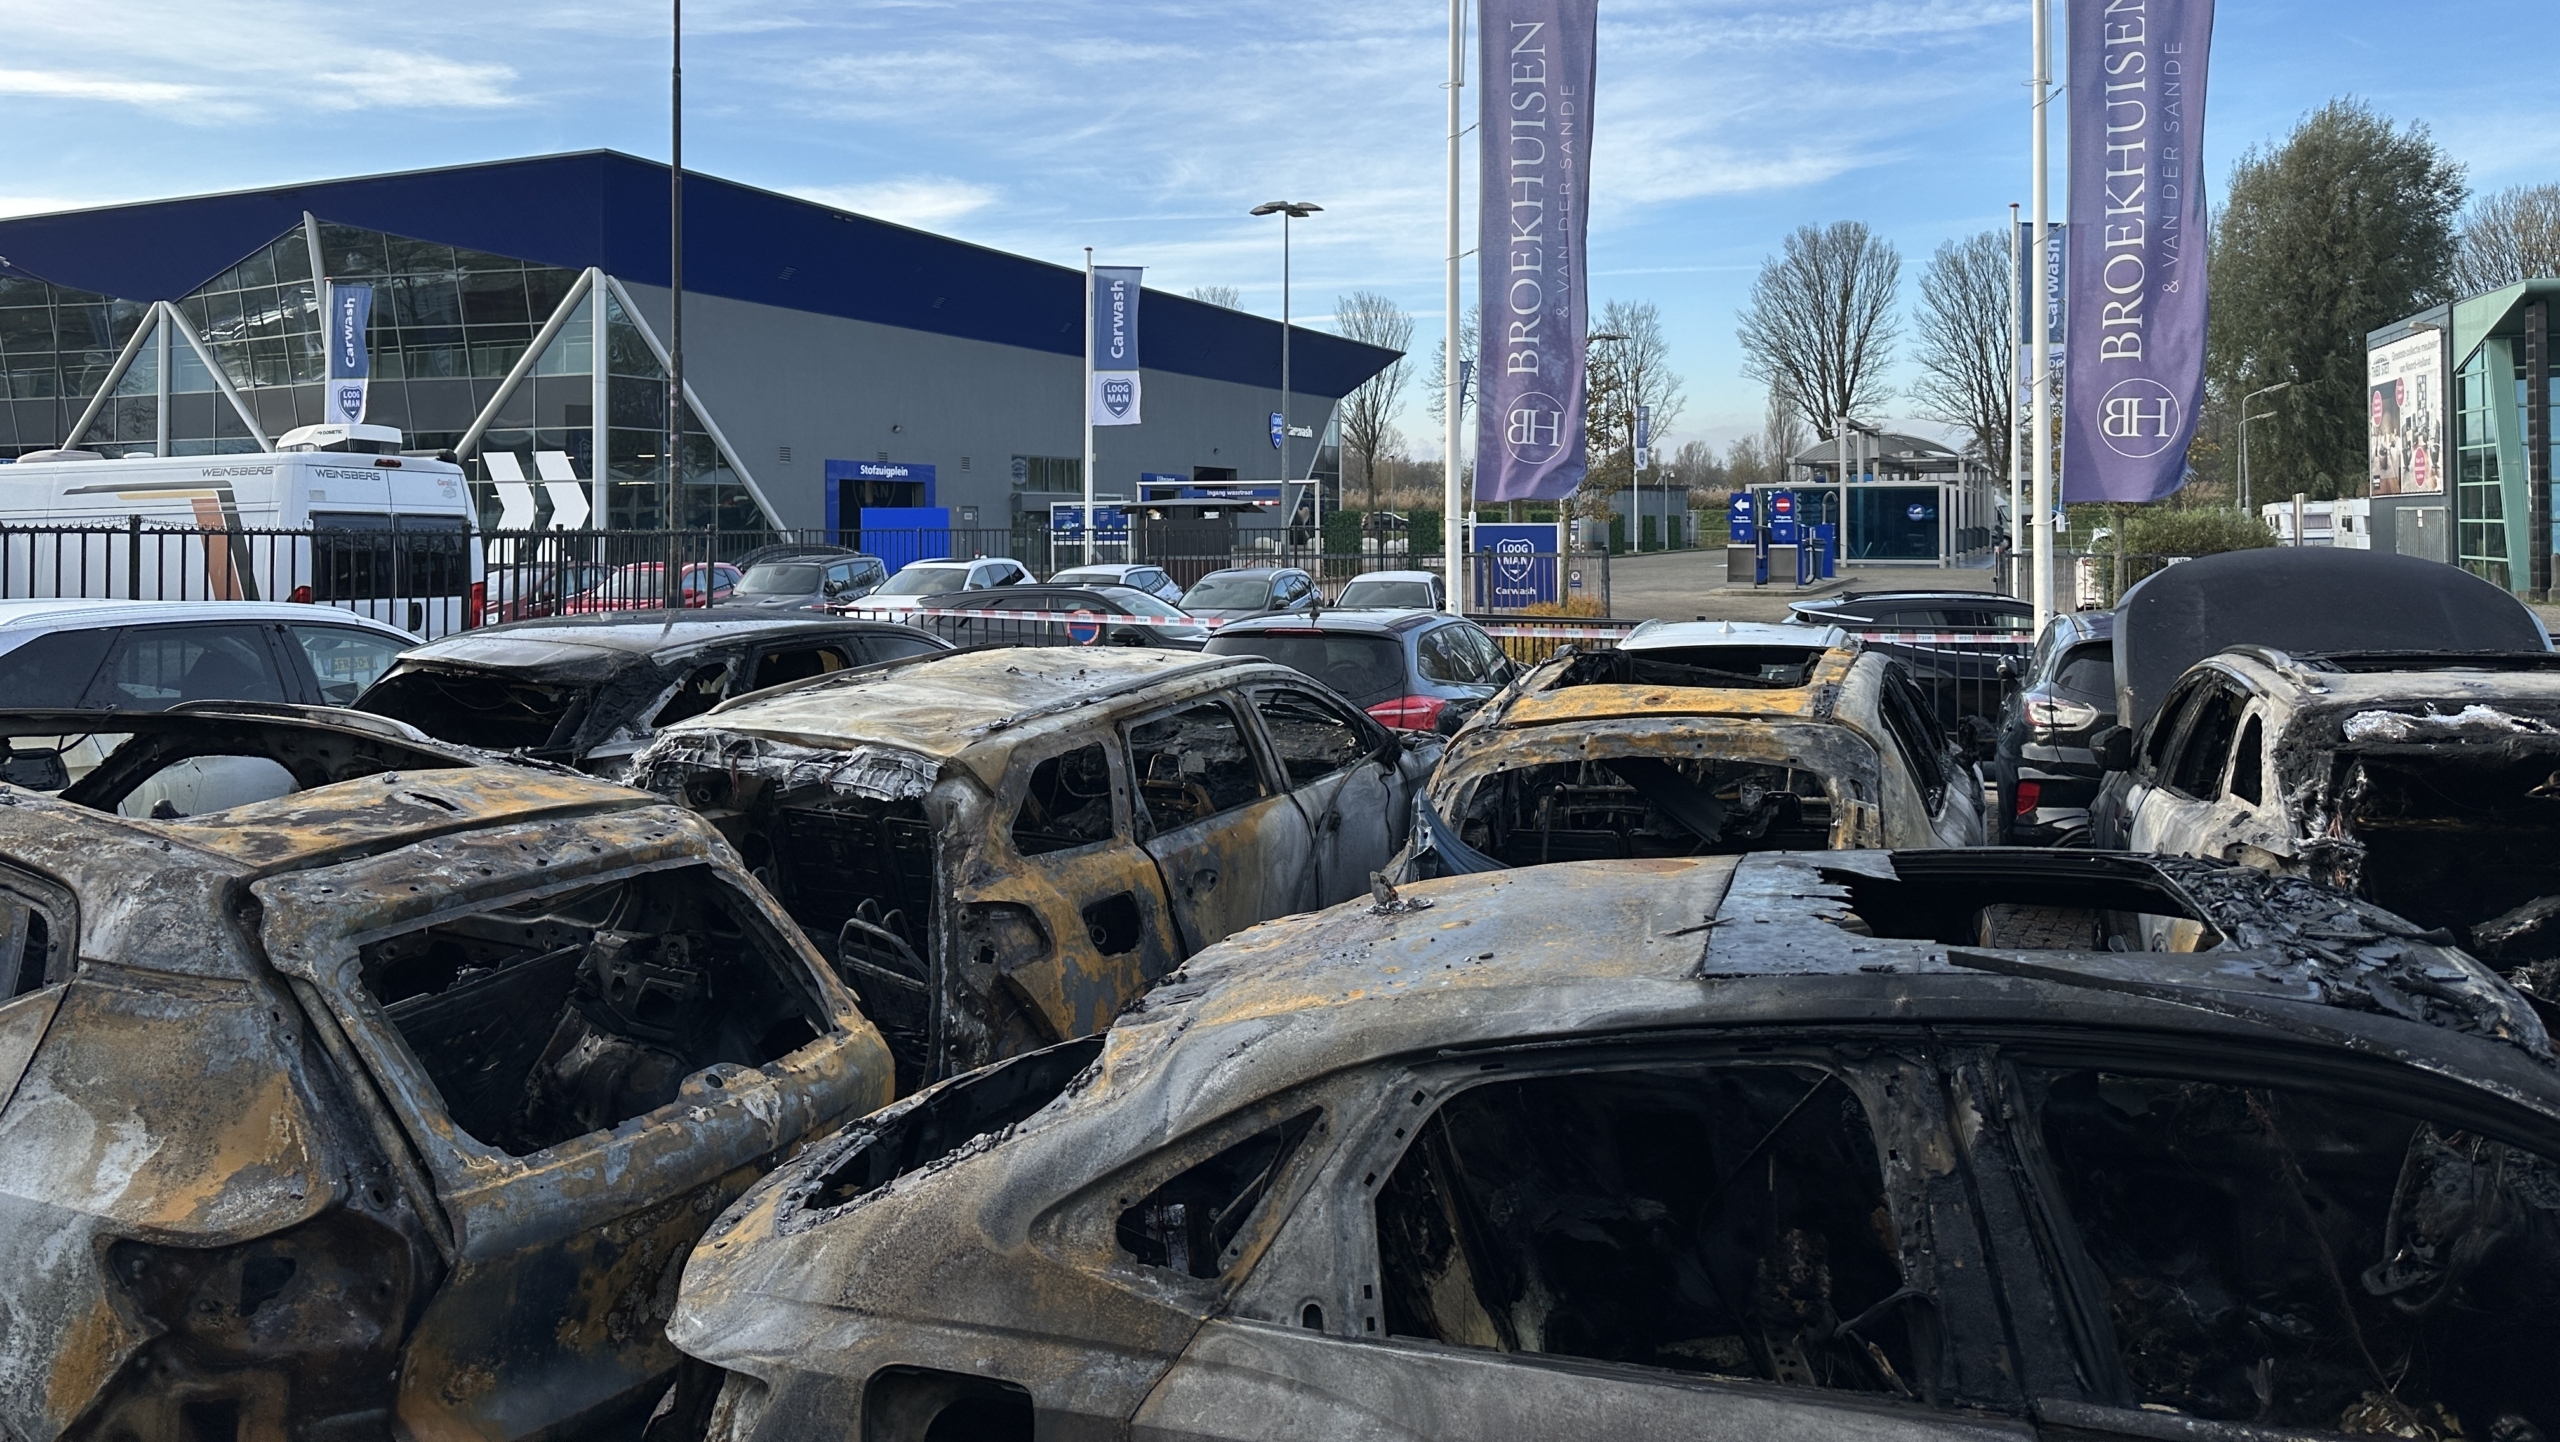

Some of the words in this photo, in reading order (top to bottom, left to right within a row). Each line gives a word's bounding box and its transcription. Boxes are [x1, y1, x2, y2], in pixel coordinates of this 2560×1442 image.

[2164, 42, 2182, 132] SANDE
[1560, 85, 1574, 169] SANDE
[2163, 147, 2178, 199] DER
[1507, 20, 1547, 378] BROEKHUISEN
[1558, 182, 1570, 230] DER
[2162, 216, 2179, 267] VAN
[1557, 246, 1570, 293] VAN
[2162, 280, 2179, 293] &
[1556, 305, 1569, 318] &
[1110, 280, 1124, 359] Carwash
[344, 297, 356, 368] Carwash
[343, 391, 360, 399] LOOG
[1107, 384, 1129, 393] LOOG
[343, 399, 360, 408] MAN
[1108, 394, 1129, 403] MAN
[202, 466, 274, 477] WEINSBERG
[315, 468, 381, 481] WEINSBERG
[860, 464, 908, 478] Stofzuigplein
[1206, 489, 1226, 497] Ingang
[1502, 544, 1528, 553] LOOG
[1503, 556, 1527, 565] MAN
[1495, 586, 1537, 595] Carwash
